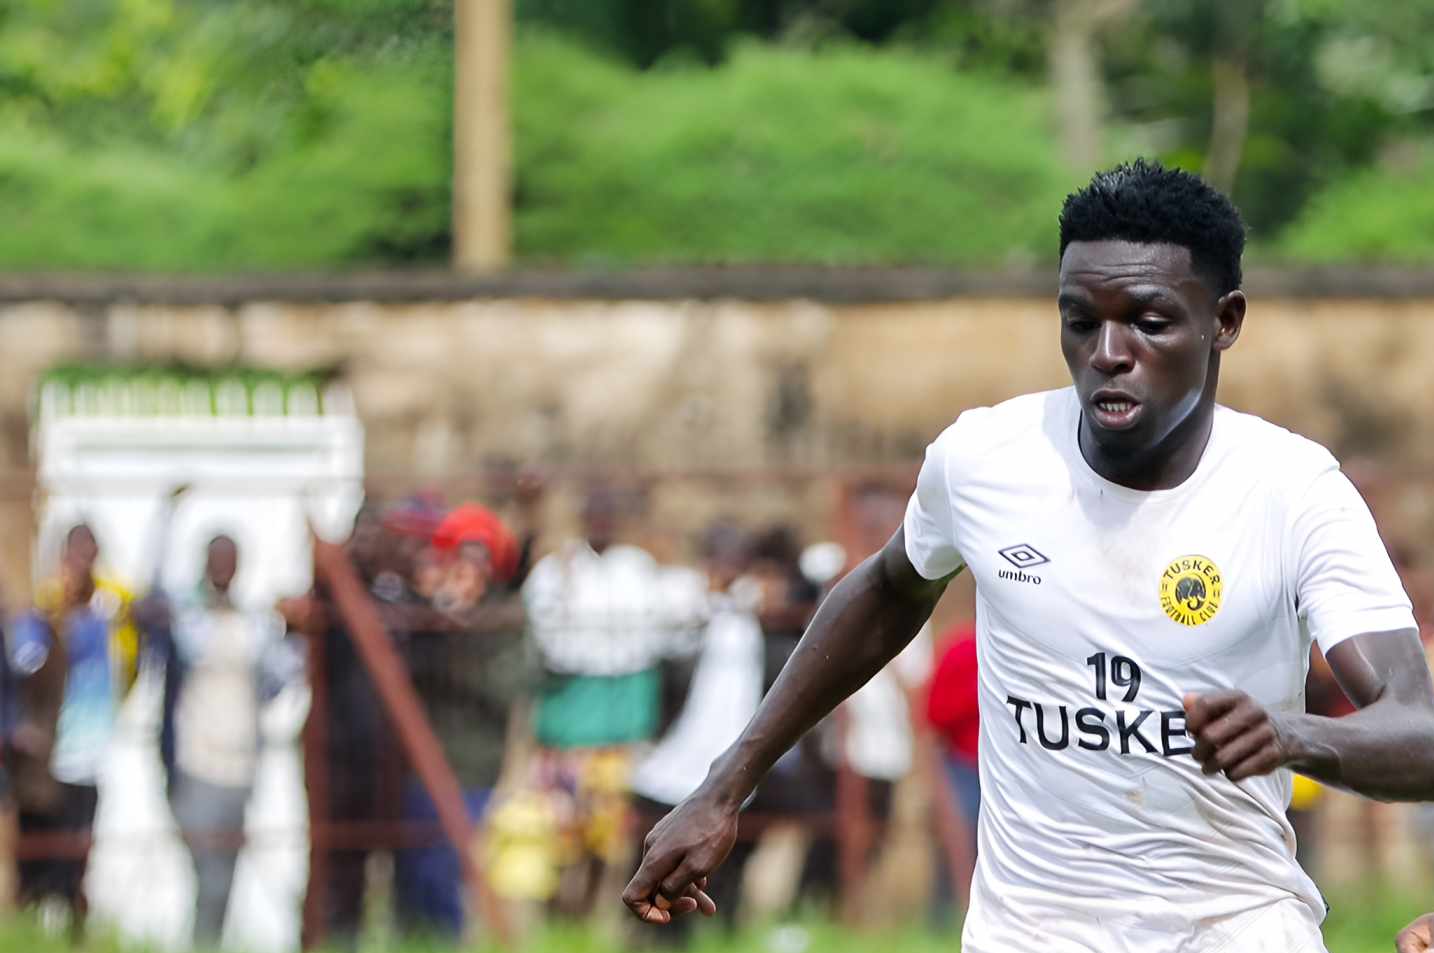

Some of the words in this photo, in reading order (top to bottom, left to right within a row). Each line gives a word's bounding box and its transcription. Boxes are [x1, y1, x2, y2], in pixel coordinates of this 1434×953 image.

[998, 568, 1042, 585] umbro
[1163, 559, 1220, 585] TUSKER
[1087, 652, 1142, 702] 19
[1006, 695, 1196, 756] TUSKE
